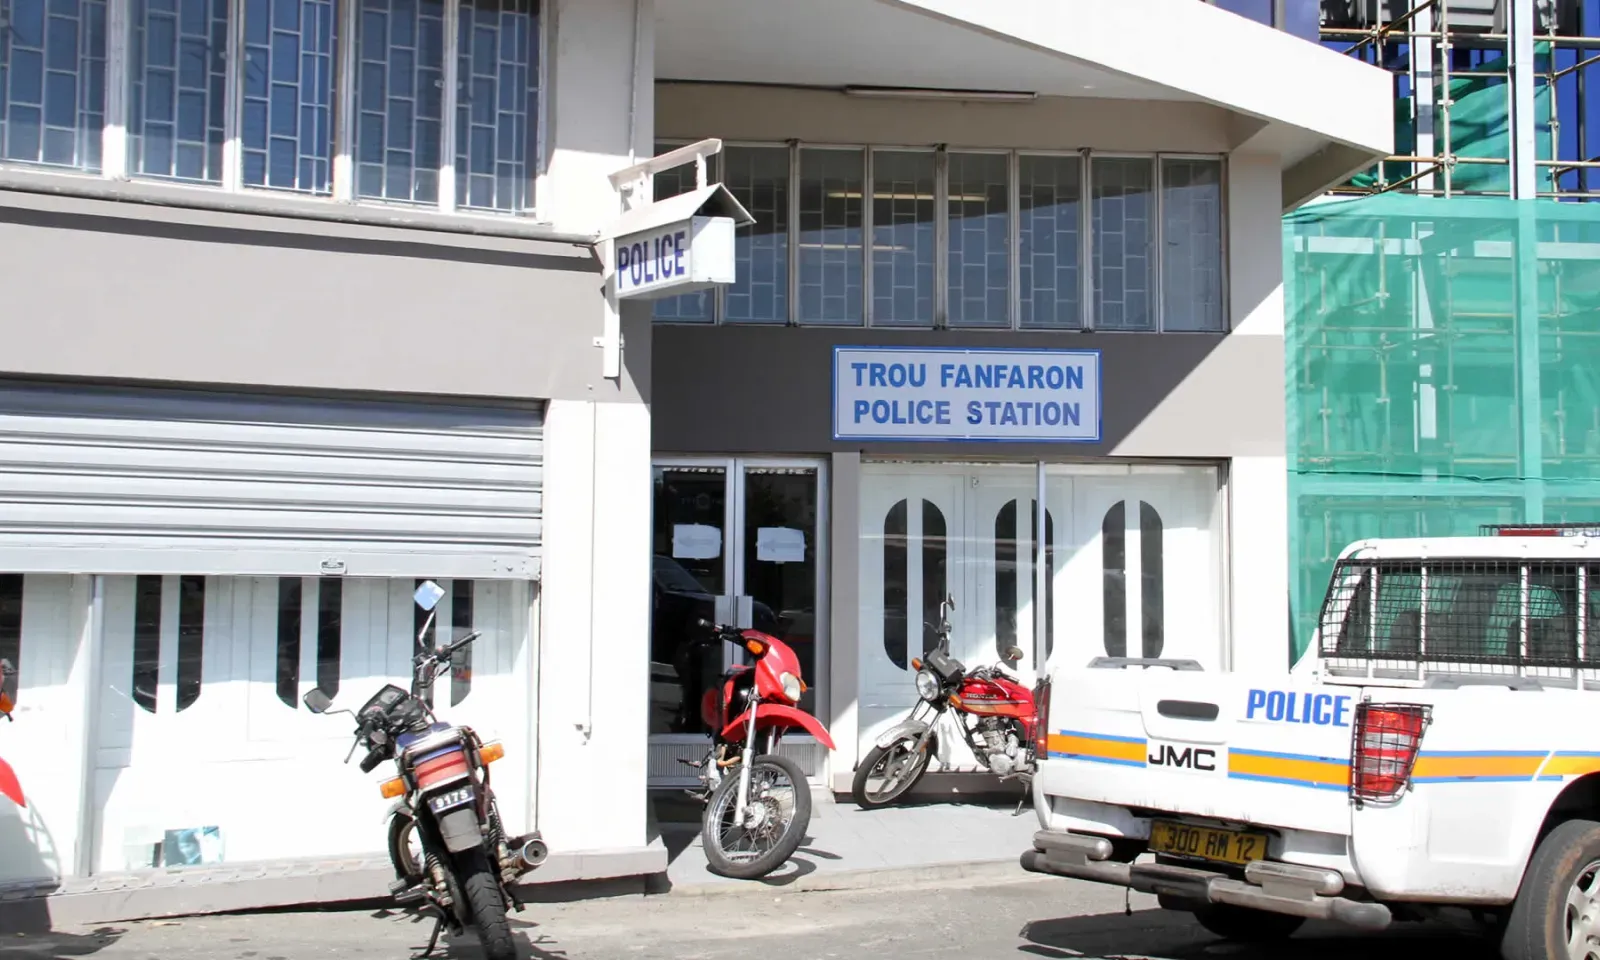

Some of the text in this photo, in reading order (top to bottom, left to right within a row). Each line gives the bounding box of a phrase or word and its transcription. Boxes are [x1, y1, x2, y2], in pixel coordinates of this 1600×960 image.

[617, 231, 685, 289] POLICE
[851, 363, 1083, 389] TROU FANFARON
[854, 400, 1080, 426] POLICE STATION
[1246, 688, 1351, 727] POLICE
[1148, 745, 1216, 771] JMC
[1165, 825, 1199, 852] 300
[1236, 837, 1256, 861] 12
